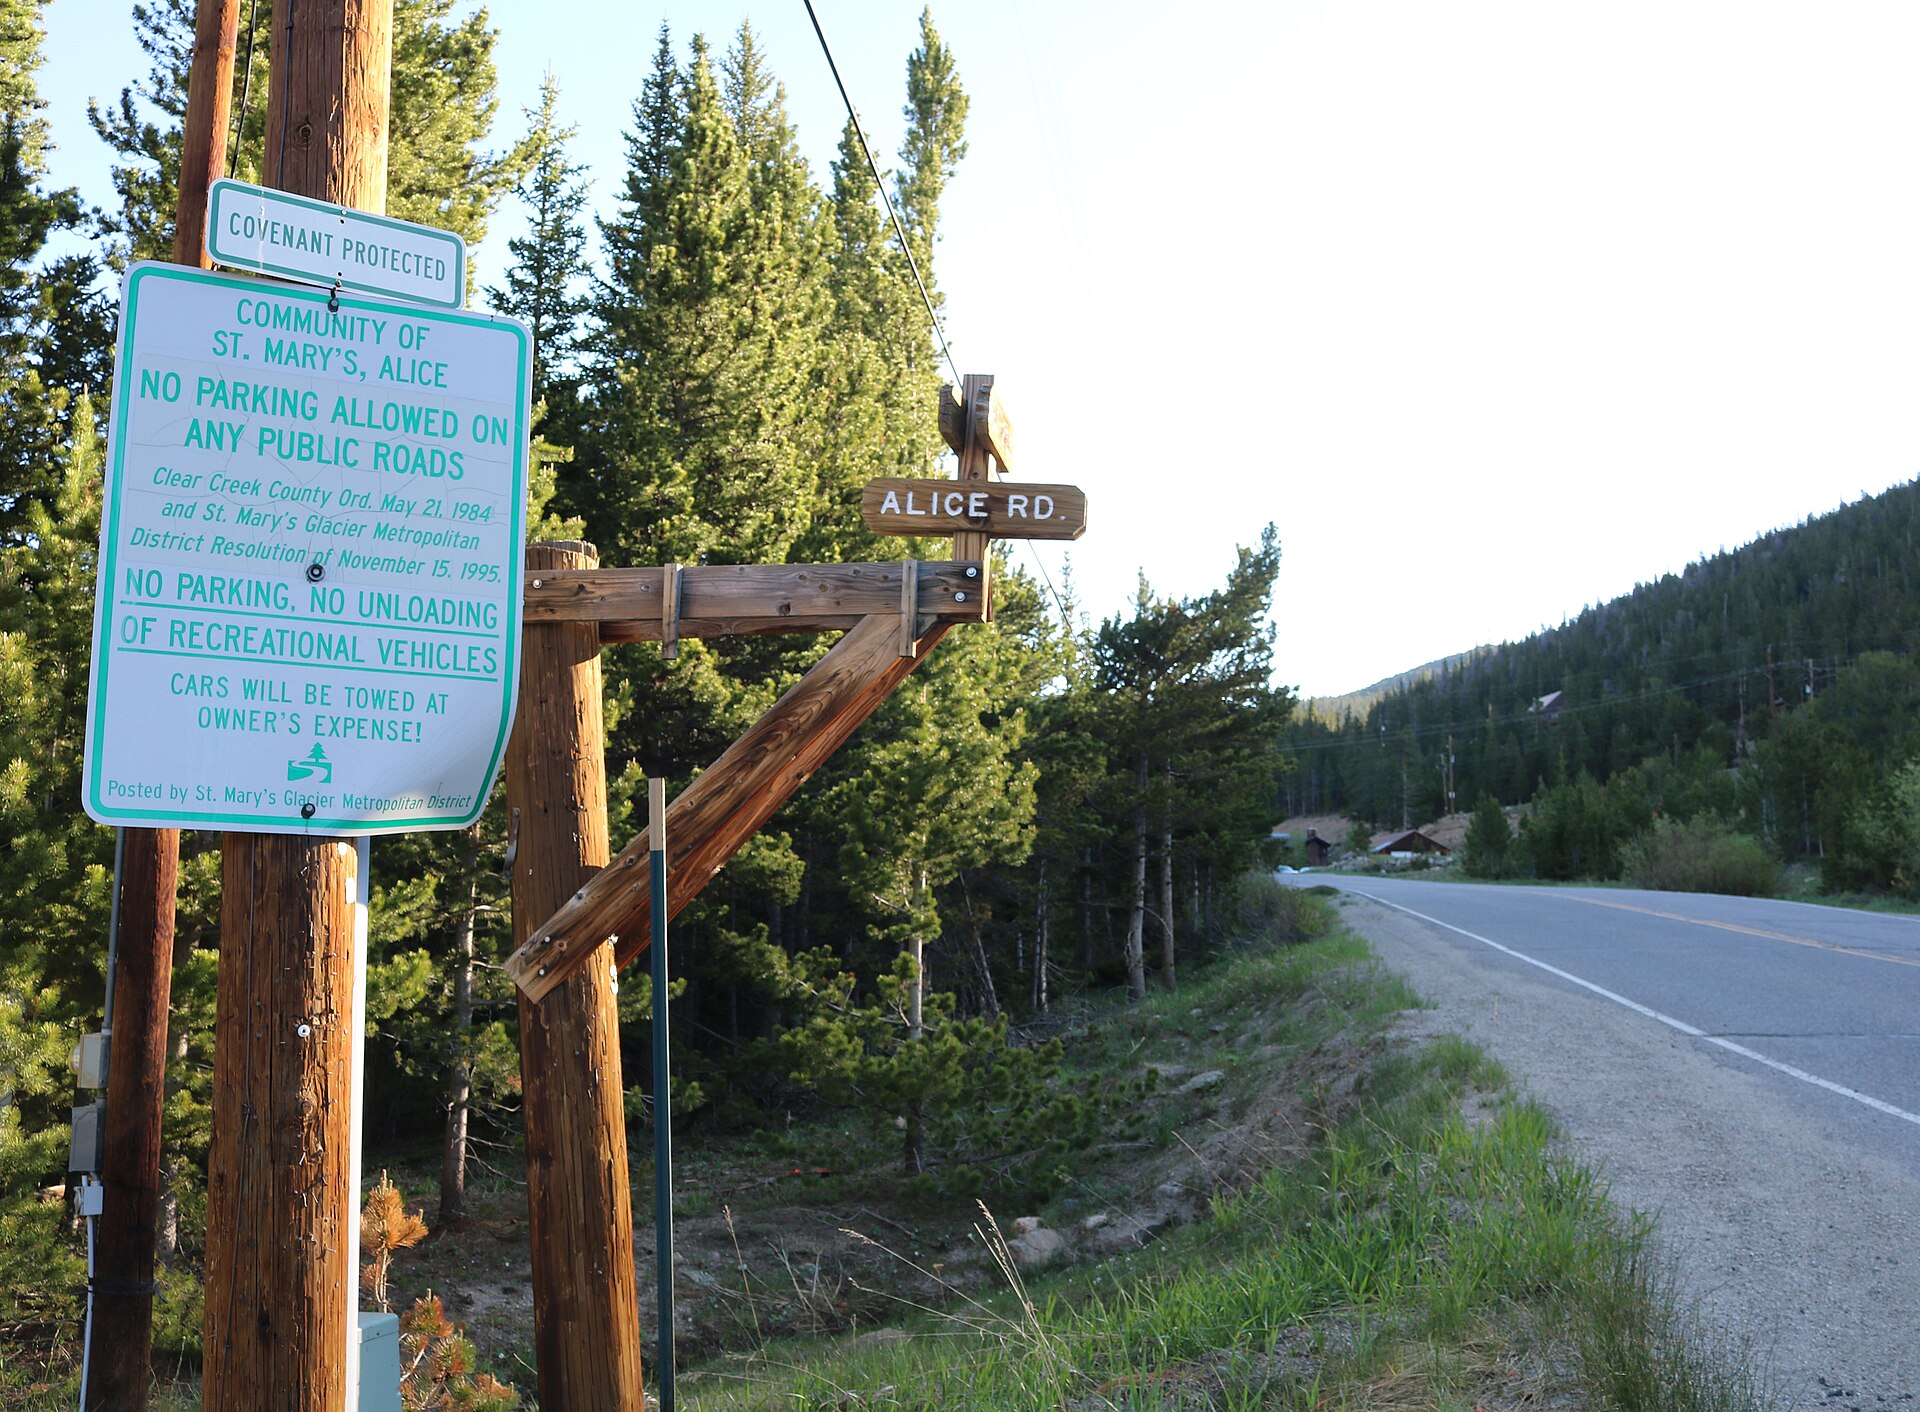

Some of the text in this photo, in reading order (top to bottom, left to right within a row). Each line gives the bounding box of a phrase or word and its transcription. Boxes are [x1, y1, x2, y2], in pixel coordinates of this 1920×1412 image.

[229, 213, 446, 282] COVENANT PROTECTED
[236, 299, 430, 350] COMMUNITY OF
[212, 329, 448, 389] ST. MARY'S, ALICE
[140, 369, 508, 446] NO PARKING ALLOWED ON
[184, 418, 464, 481] ANY PUBLIC ROADS
[153, 467, 201, 490] Clear
[209, 473, 261, 497] Creek
[269, 480, 332, 511] County
[339, 490, 372, 511] Ord.
[381, 493, 417, 517] May
[453, 502, 492, 523] 1984
[880, 491, 1066, 520] ALICE RD.
[130, 527, 204, 553] District
[210, 536, 305, 565] Resolution
[312, 546, 331, 567] of
[337, 550, 427, 576] November
[161, 501, 480, 551] and St. Mary's Glacier Metropolitan
[125, 568, 498, 630] NO PARKING, NO UNLOADING
[121, 615, 497, 674] OF RECREATIONAL VEHICLES
[170, 672, 449, 714] CARS WILL BE TOWED AT
[198, 706, 422, 743] OWNER'S EXPENSE!
[108, 780, 472, 814] Posted by St. Mary's Glacier Metropolitan District
